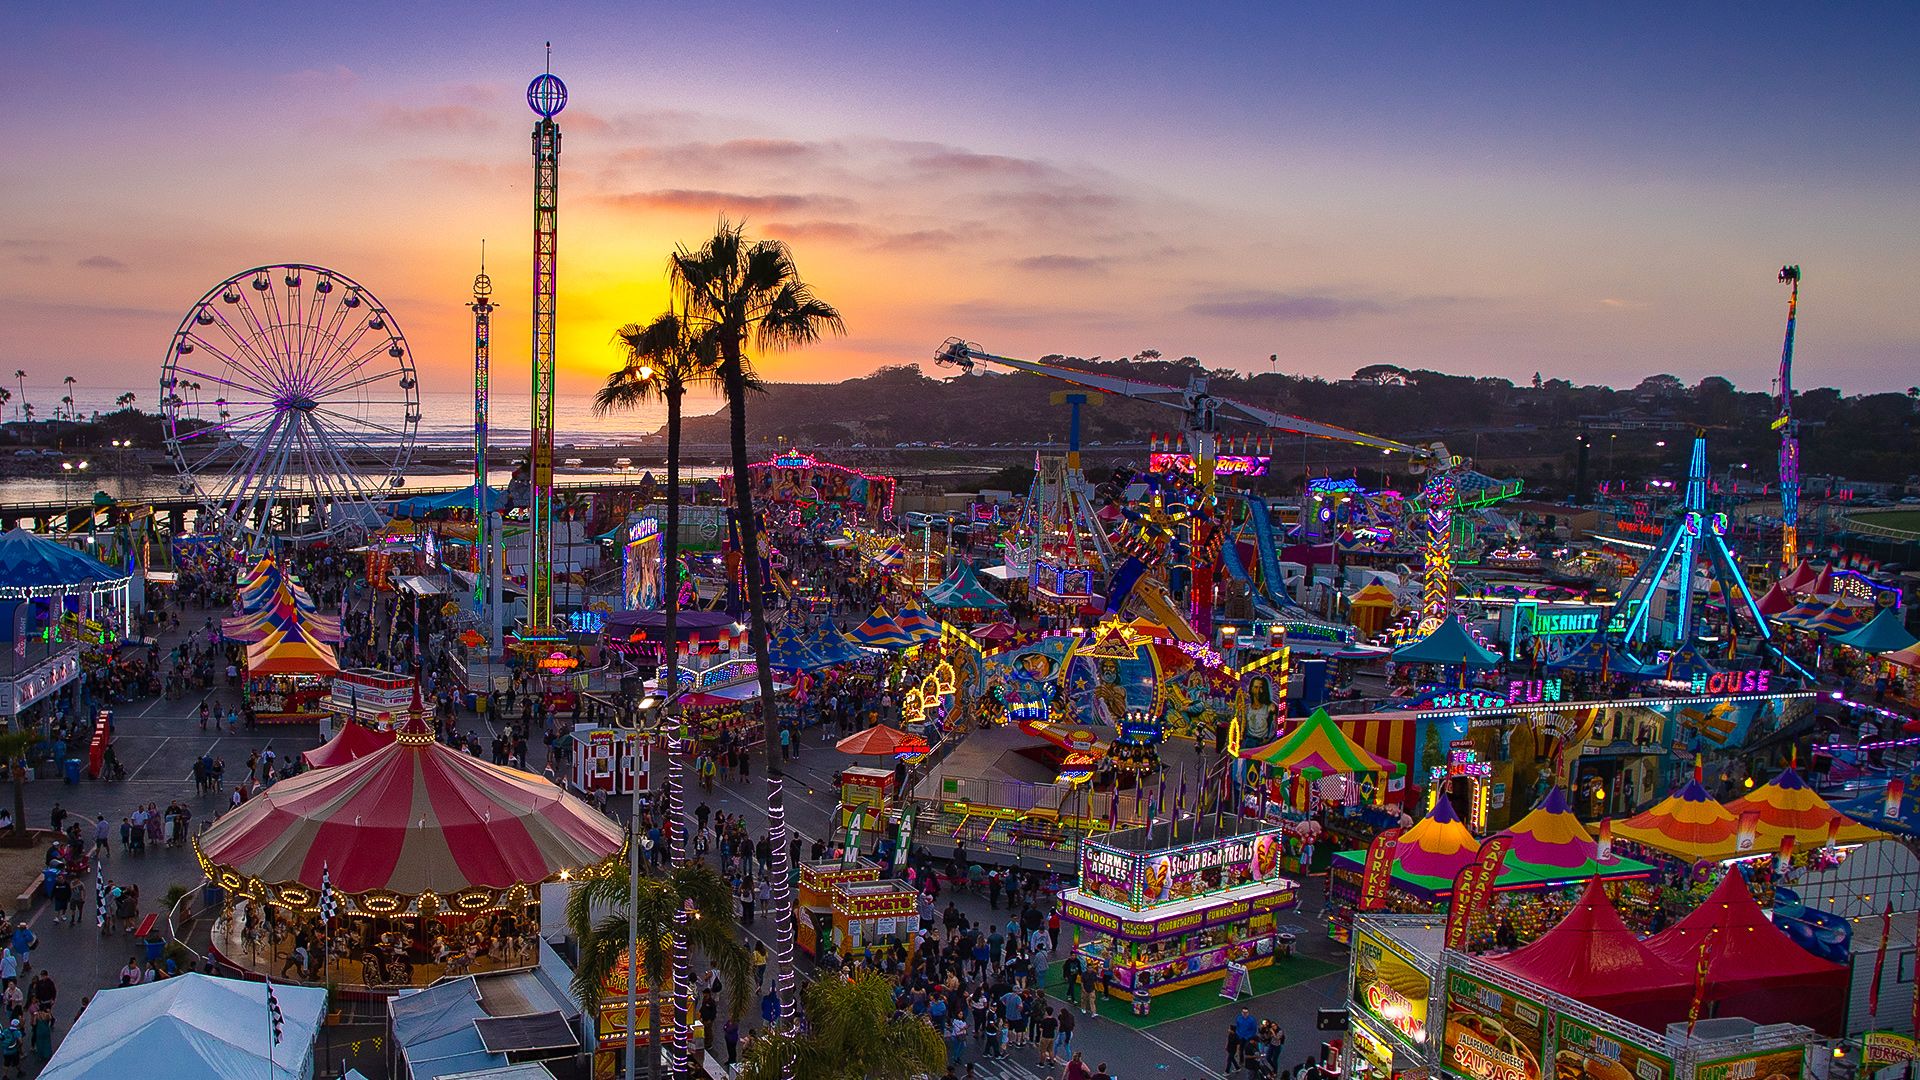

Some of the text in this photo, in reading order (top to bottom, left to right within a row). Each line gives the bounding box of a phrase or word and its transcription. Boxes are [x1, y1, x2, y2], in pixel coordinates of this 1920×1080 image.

[1537, 614, 1599, 632] INSANITY
[1432, 670, 1771, 708] TWISTED FUN HOUSE
[844, 813, 861, 863] ATM
[895, 815, 911, 865] ATM
[1086, 847, 1134, 870] GOURMET
[1171, 841, 1254, 877] SUGAR BEAR TREATS
[1365, 837, 1386, 908] TURKEY
[855, 897, 911, 912] TICKETS
[1208, 902, 1250, 920] FUNNEL CAKES
[1450, 869, 1474, 949] SAUSAGE
[1068, 906, 1118, 930] CORN DOGS
[1123, 922, 1134, 930] ICE
[1125, 929, 1152, 937] DRINKS
[1361, 940, 1382, 961] FRESH
[1380, 981, 1413, 1012] ROASTED
[1368, 986, 1425, 1042] CORN
[1875, 1036, 1908, 1047] TEXAS
[1501, 1050, 1525, 1071] CHEESE
[1868, 1046, 1915, 1062] TURKEY
